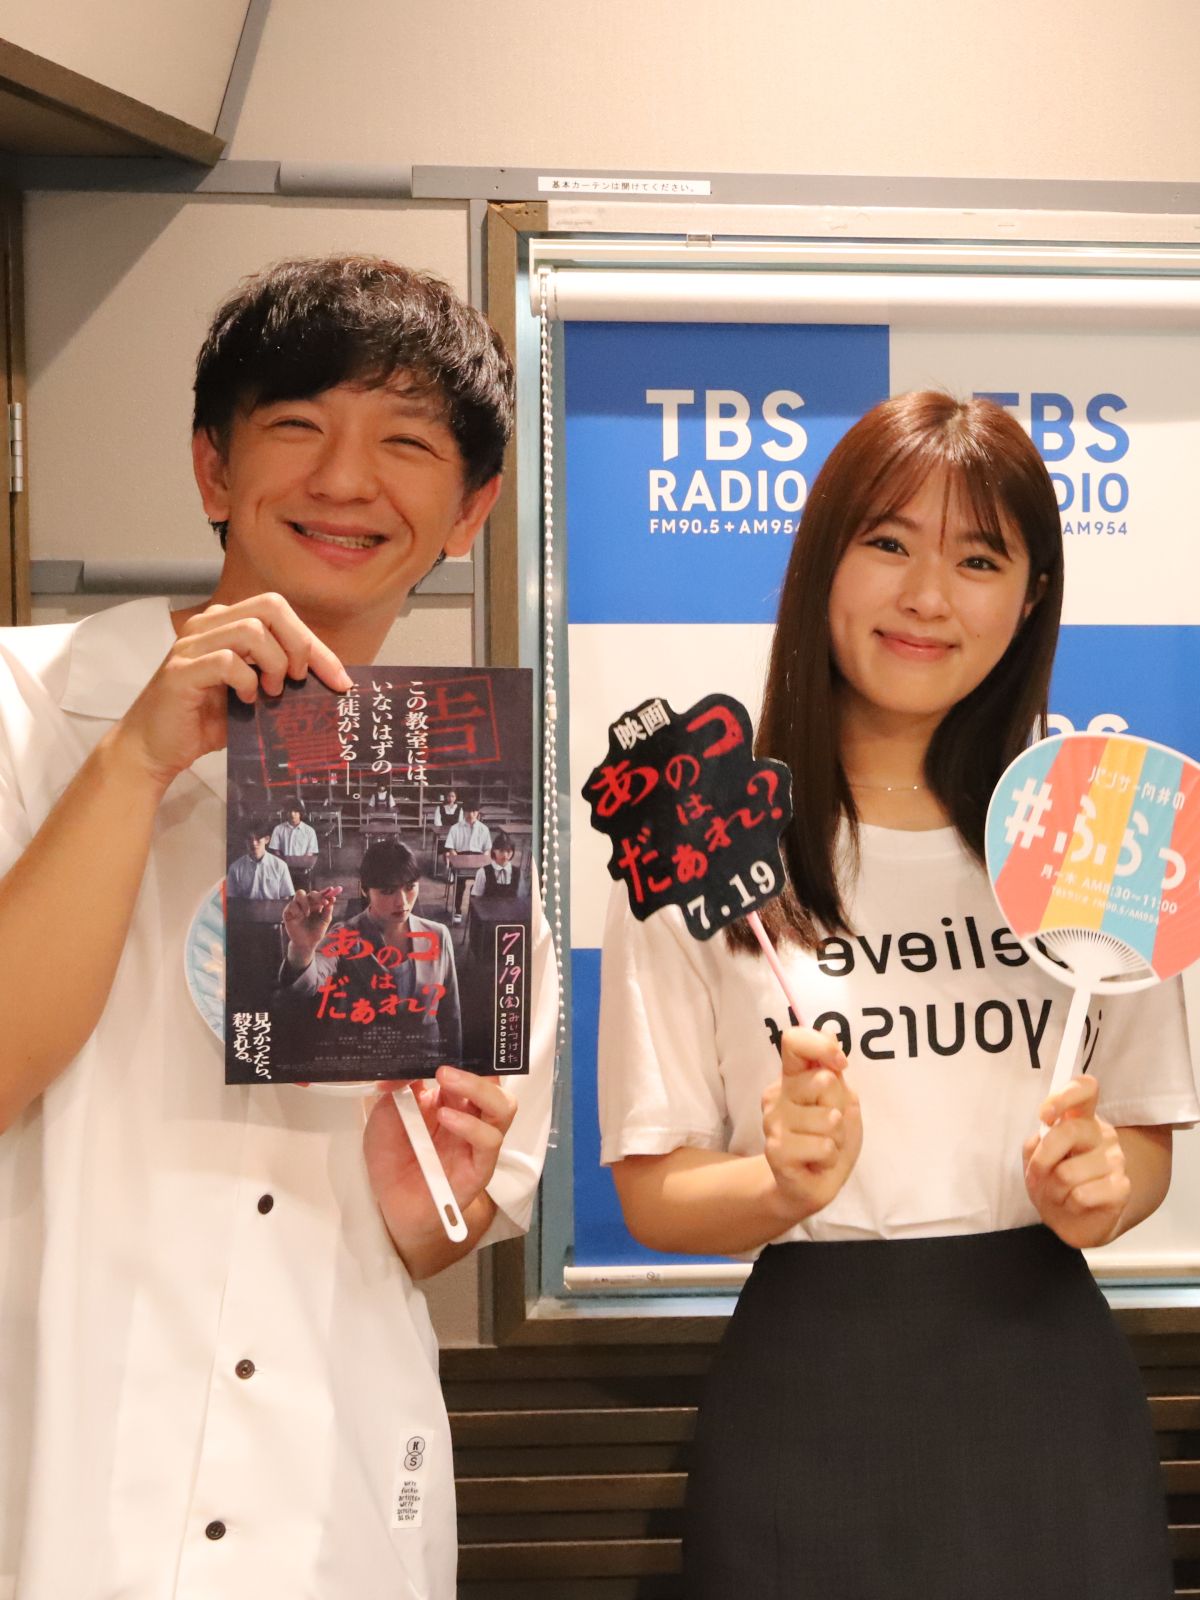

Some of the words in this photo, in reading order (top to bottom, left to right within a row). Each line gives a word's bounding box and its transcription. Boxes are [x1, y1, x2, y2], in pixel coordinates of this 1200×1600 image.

[552, 180, 695, 192] 基本カーテンは開けてください。
[646, 389, 808, 462] TBS
[649, 469, 807, 513] RADIO
[371, 680, 393, 775] いないはずの
[405, 680, 429, 786] この教室には、
[613, 700, 671, 750] 映画
[675, 793, 714, 826] は
[687, 860, 776, 930] 7.19
[370, 973, 397, 990] は
[232, 1012, 253, 1063] 殺される。
[253, 1012, 272, 1080] 見つかったら、
[409, 1456, 417, 1466] S
